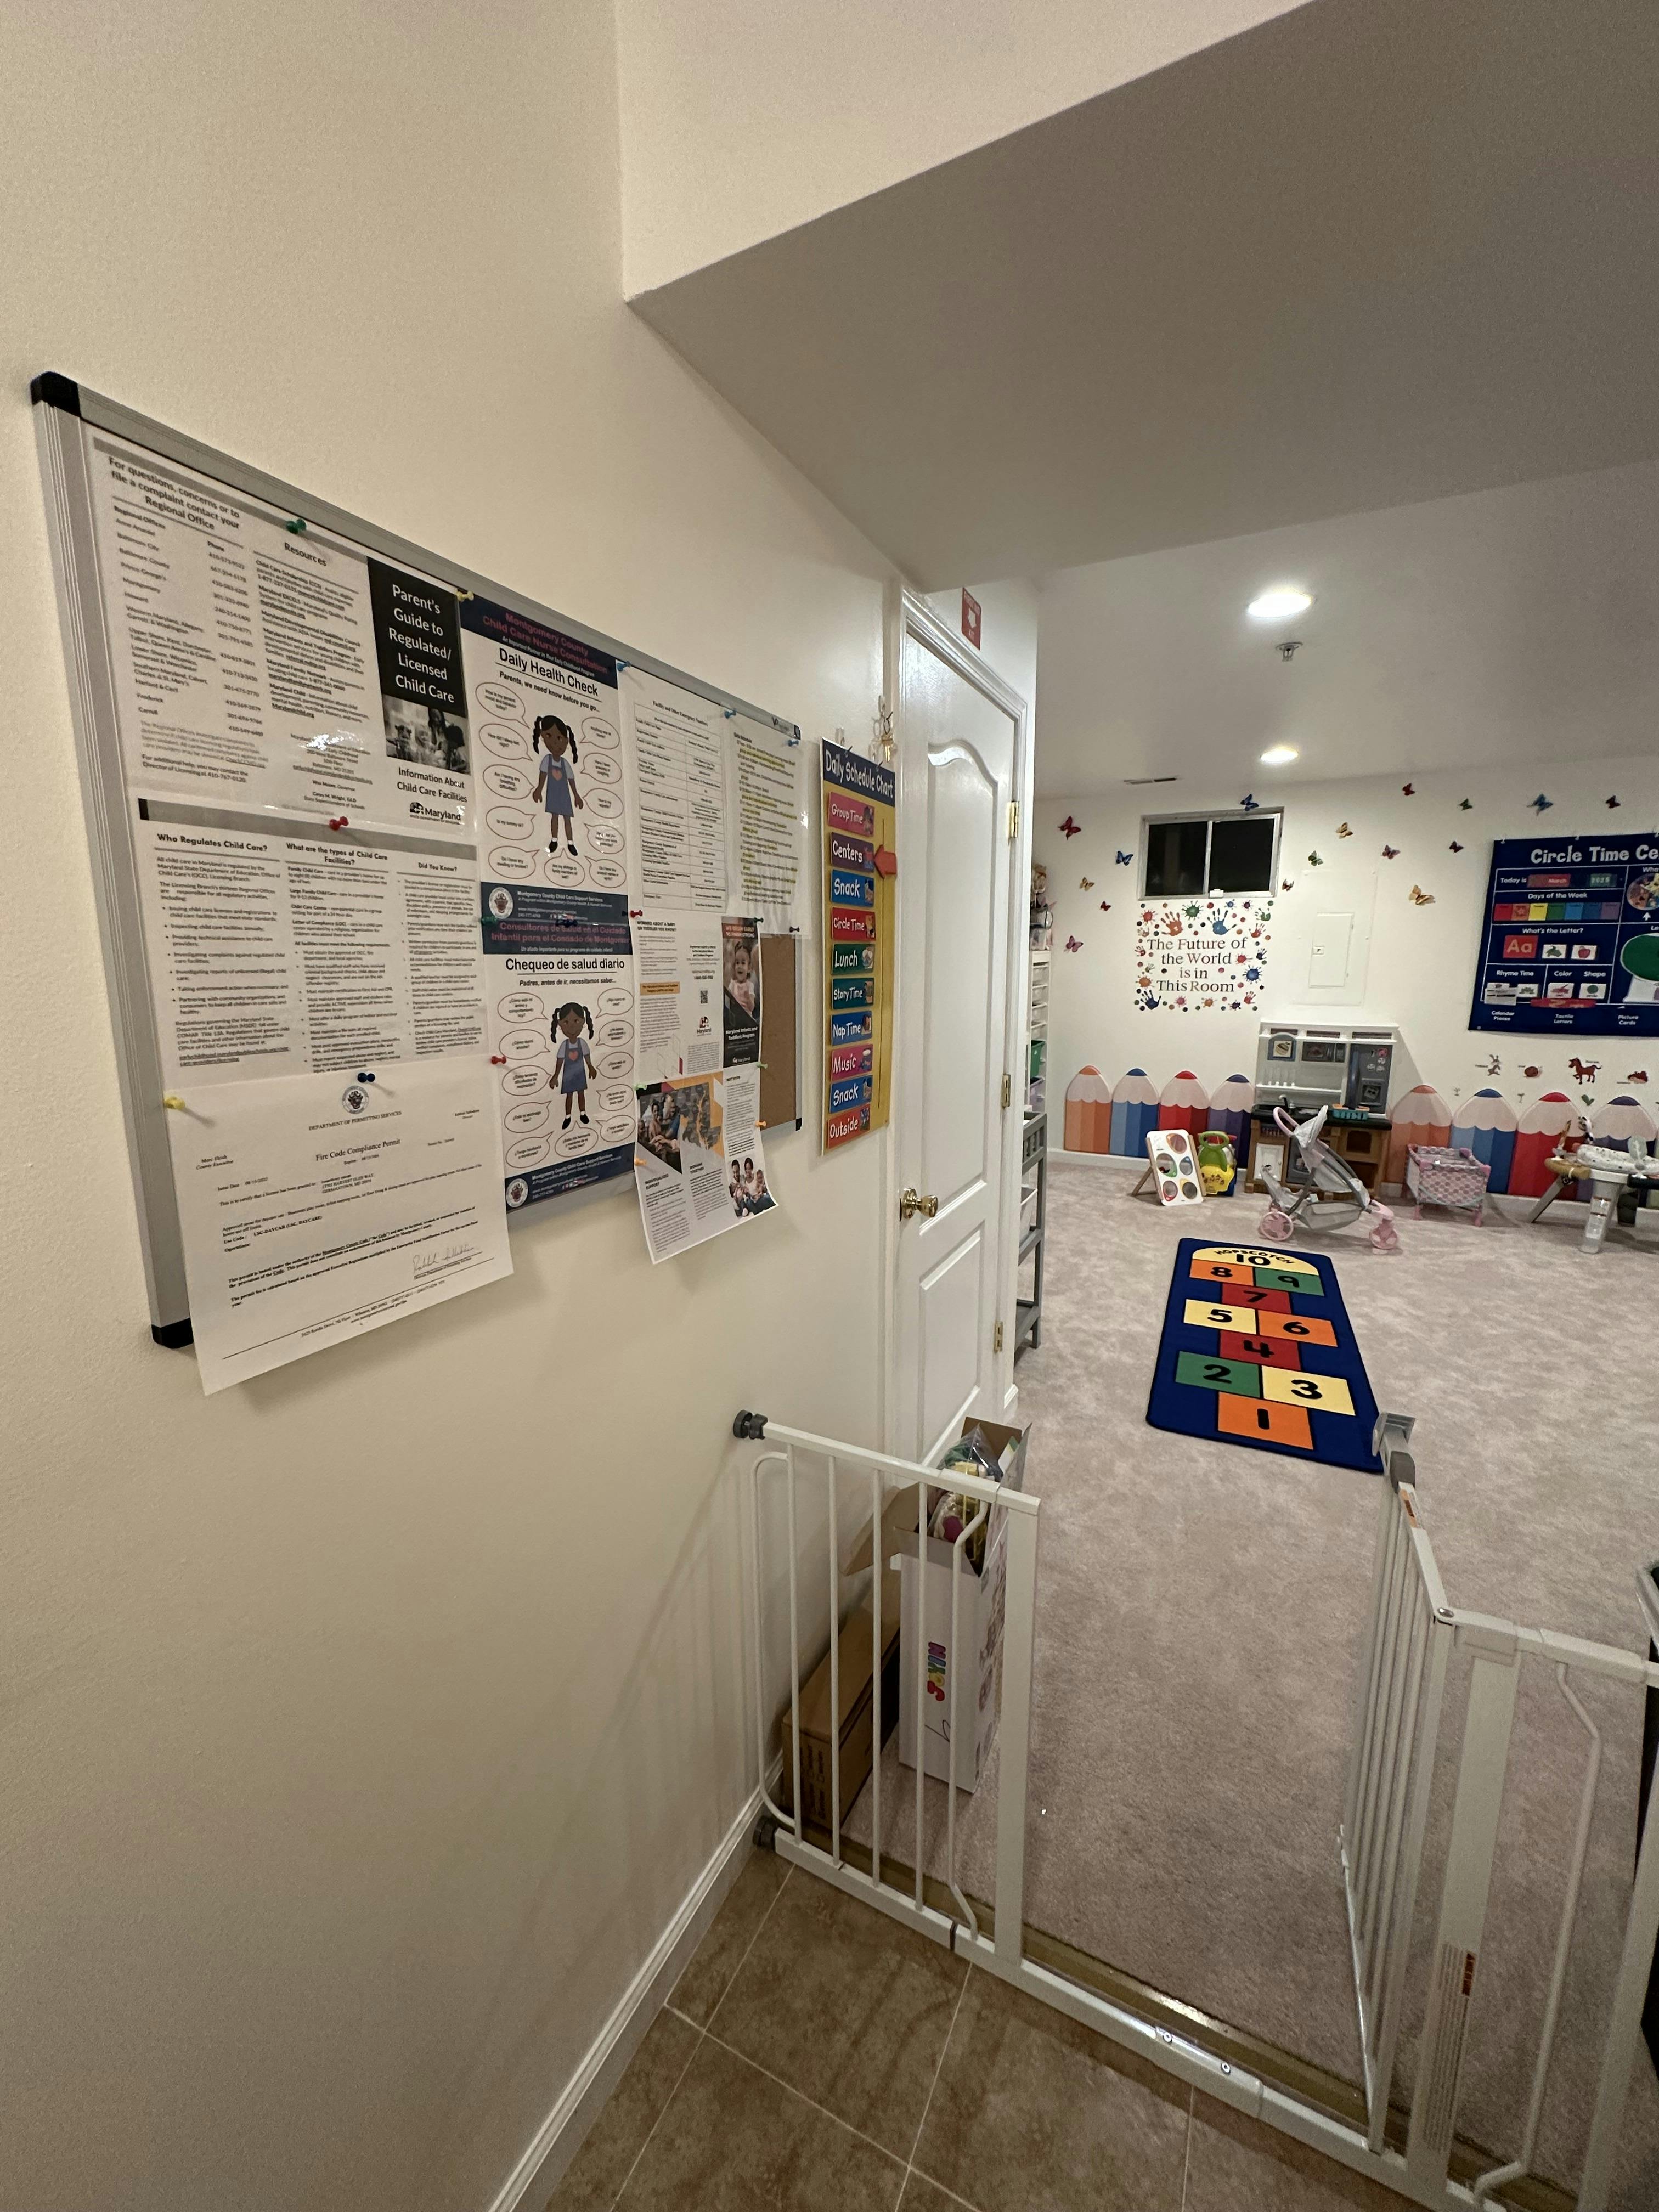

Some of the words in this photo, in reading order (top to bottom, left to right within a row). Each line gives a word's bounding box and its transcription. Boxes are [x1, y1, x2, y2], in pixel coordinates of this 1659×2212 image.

[109, 456, 125, 470] For
[128, 465, 177, 492] questions,
[179, 488, 217, 509] concerns
[219, 504, 228, 514] or
[230, 509, 240, 518] to
[111, 471, 127, 483] file
[138, 483, 184, 507] complaint
[187, 501, 218, 520] contact
[221, 516, 239, 529] your
[145, 495, 185, 518] Regional
[188, 514, 215, 530] Office
[284, 542, 326, 566] Resources
[392, 584, 441, 614] Parent's
[394, 607, 430, 631] Guide
[432, 622, 443, 636] to
[388, 627, 452, 661] Regulated/
[483, 616, 507, 632] Child
[510, 627, 532, 642] Care
[533, 636, 558, 652] Nurse
[560, 648, 608, 673] Consultation
[505, 612, 560, 644] Montgomery
[561, 637, 589, 657] County
[398, 652, 448, 680] Licensed
[499, 648, 527, 672] Daily
[531, 660, 565, 684] Health
[567, 675, 599, 696] Check
[396, 674, 426, 695] Child
[428, 685, 454, 703] Care
[499, 671, 523, 686] Parents,
[533, 684, 548, 693] need
[549, 689, 562, 699] know
[563, 693, 579, 704] before
[580, 701, 589, 709] you
[399, 767, 443, 783] Information
[445, 777, 465, 789] About
[826, 749, 844, 783] Daily
[845, 761, 875, 792] Schedule
[876, 775, 893, 798] Chart
[397, 781, 417, 793] Child
[419, 786, 436, 796] Care
[438, 789, 467, 803] Facilities
[425, 808, 461, 821] Maryland
[831, 803, 849, 822] Group
[850, 810, 863, 824] Time
[157, 833, 178, 843] Who
[180, 836, 222, 847] Regulates
[224, 840, 244, 849] Child
[286, 842, 304, 851] What
[330, 848, 346, 856] types
[832, 840, 863, 863] Centers
[324, 856, 355, 865] Facilities?
[1531, 845, 1582, 864] Circle
[1589, 846, 1629, 862] Time
[1635, 844, 1659, 860] Ce
[834, 878, 860, 898] Snack
[500, 922, 549, 932] Consultores
[833, 917, 850, 929] Circle
[850, 919, 865, 931] Time
[1147, 939, 1173, 950] The
[1178, 939, 1226, 950] Future
[1231, 937, 1248, 949] of
[1506, 939, 1532, 953] Aa
[506, 958, 554, 972] Chequeo
[557, 959, 569, 969] de
[572, 958, 597, 969] salud
[600, 958, 625, 969] diario
[834, 950, 857, 968] Lunch
[1161, 953, 1183, 964] the
[1187, 952, 1232, 964] World
[1180, 967, 1190, 978] is
[1194, 967, 1208, 979] in
[833, 989, 849, 1002] Story
[849, 988, 863, 999] Time
[1156, 980, 1187, 991] This
[1190, 980, 1234, 992] Room
[833, 1023, 845, 1040] Nap
[846, 1022, 861, 1036] Time
[833, 1053, 856, 1074] Music
[833, 1083, 859, 1107] Snack
[308, 1121, 343, 1131] DEPARTMENT
[351, 1115, 380, 1124] PERMITTING
[830, 1116, 859, 1139] Outside
[315, 1153, 328, 1161] Fire
[330, 1150, 346, 1158] Code
[347, 1142, 381, 1154] Compliance
[382, 1138, 400, 1147] Permit
[1215, 1249, 1294, 1264] HOPSCOTCH
[1236, 1254, 1271, 1266] 10
[1211, 1267, 1233, 1278] 8
[1277, 1276, 1299, 1288] 9
[1243, 1290, 1267, 1303] 7
[1207, 1309, 1232, 1323] 5
[1283, 1322, 1310, 1335] 6
[1243, 1340, 1274, 1358] 4
[1203, 1364, 1232, 1384] 2
[1291, 1379, 1323, 1400] 3
[1257, 1408, 1269, 1430] 1
[927, 1641, 946, 1701] JOYIN
